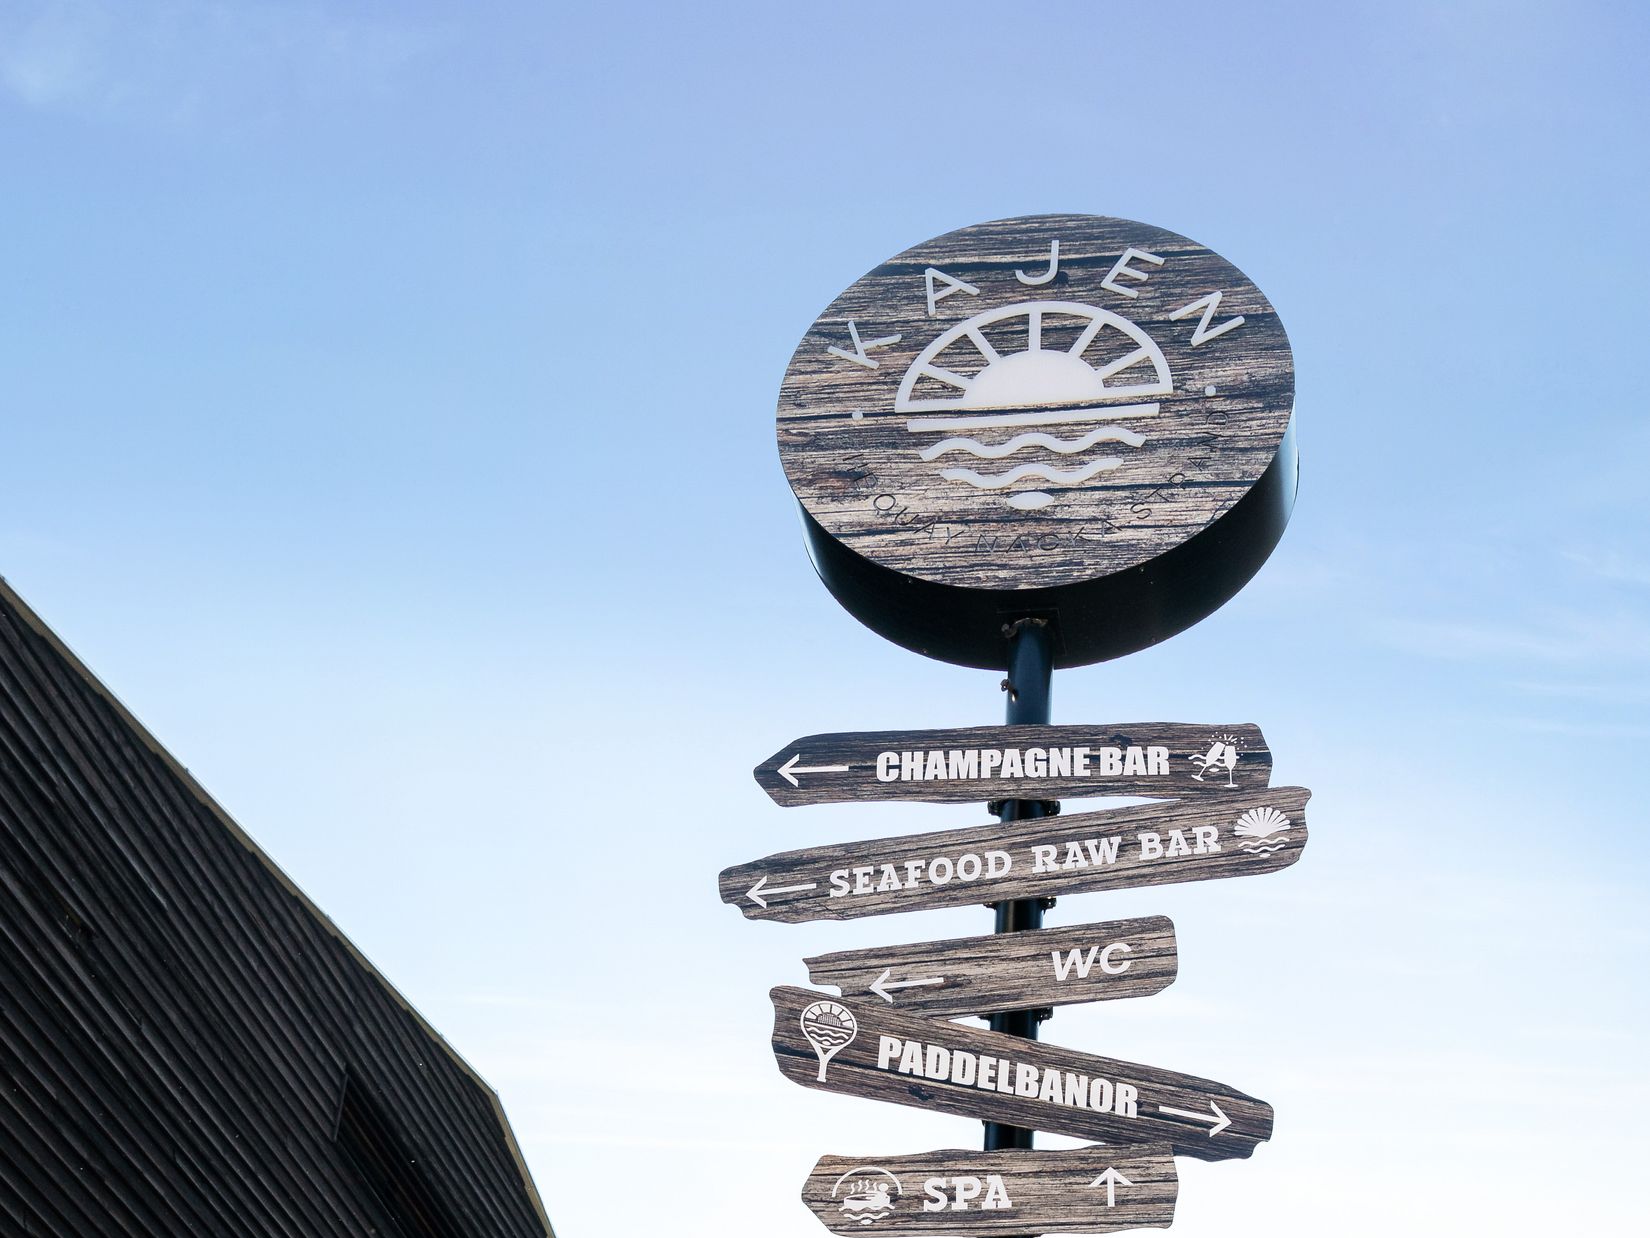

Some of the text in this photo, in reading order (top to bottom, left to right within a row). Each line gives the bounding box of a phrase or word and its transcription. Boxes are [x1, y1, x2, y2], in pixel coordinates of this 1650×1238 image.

[827, 239, 1245, 370] KAJEN
[974, 517, 1122, 554] NACKA
[876, 746, 1170, 782] CHAMPAGNE BAR
[829, 825, 1222, 899] SEAFOOD RAW BAR
[1051, 942, 1132, 982] WC
[878, 1035, 1139, 1119] PADDELBANOR
[922, 1174, 1012, 1212] SPA
